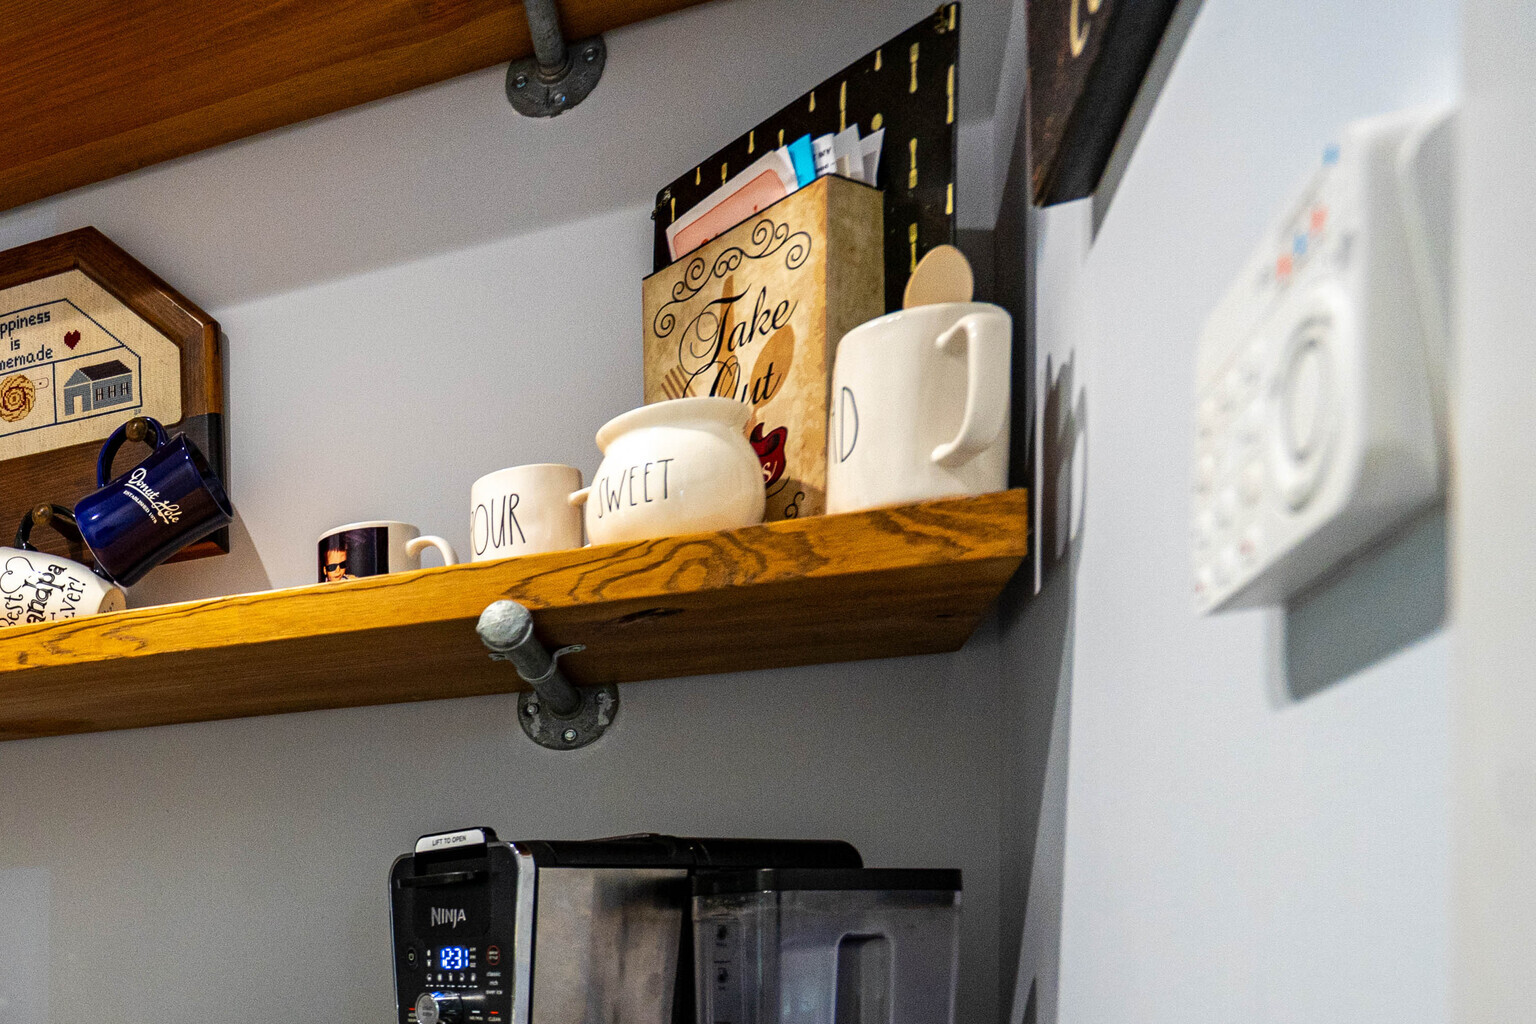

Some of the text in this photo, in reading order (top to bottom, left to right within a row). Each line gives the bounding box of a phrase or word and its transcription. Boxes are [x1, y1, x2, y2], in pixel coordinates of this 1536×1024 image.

[10, 337, 21, 351] is
[678, 283, 799, 376] Take
[127, 467, 183, 524] Donut Hole
[598, 458, 675, 519] SWEET
[470, 493, 527, 556] OUR
[21, 564, 68, 624] andpa
[60, 576, 86, 619] ver!
[431, 838, 444, 847] LIFT
[452, 834, 467, 843] OPEN
[431, 906, 467, 928] NINJA
